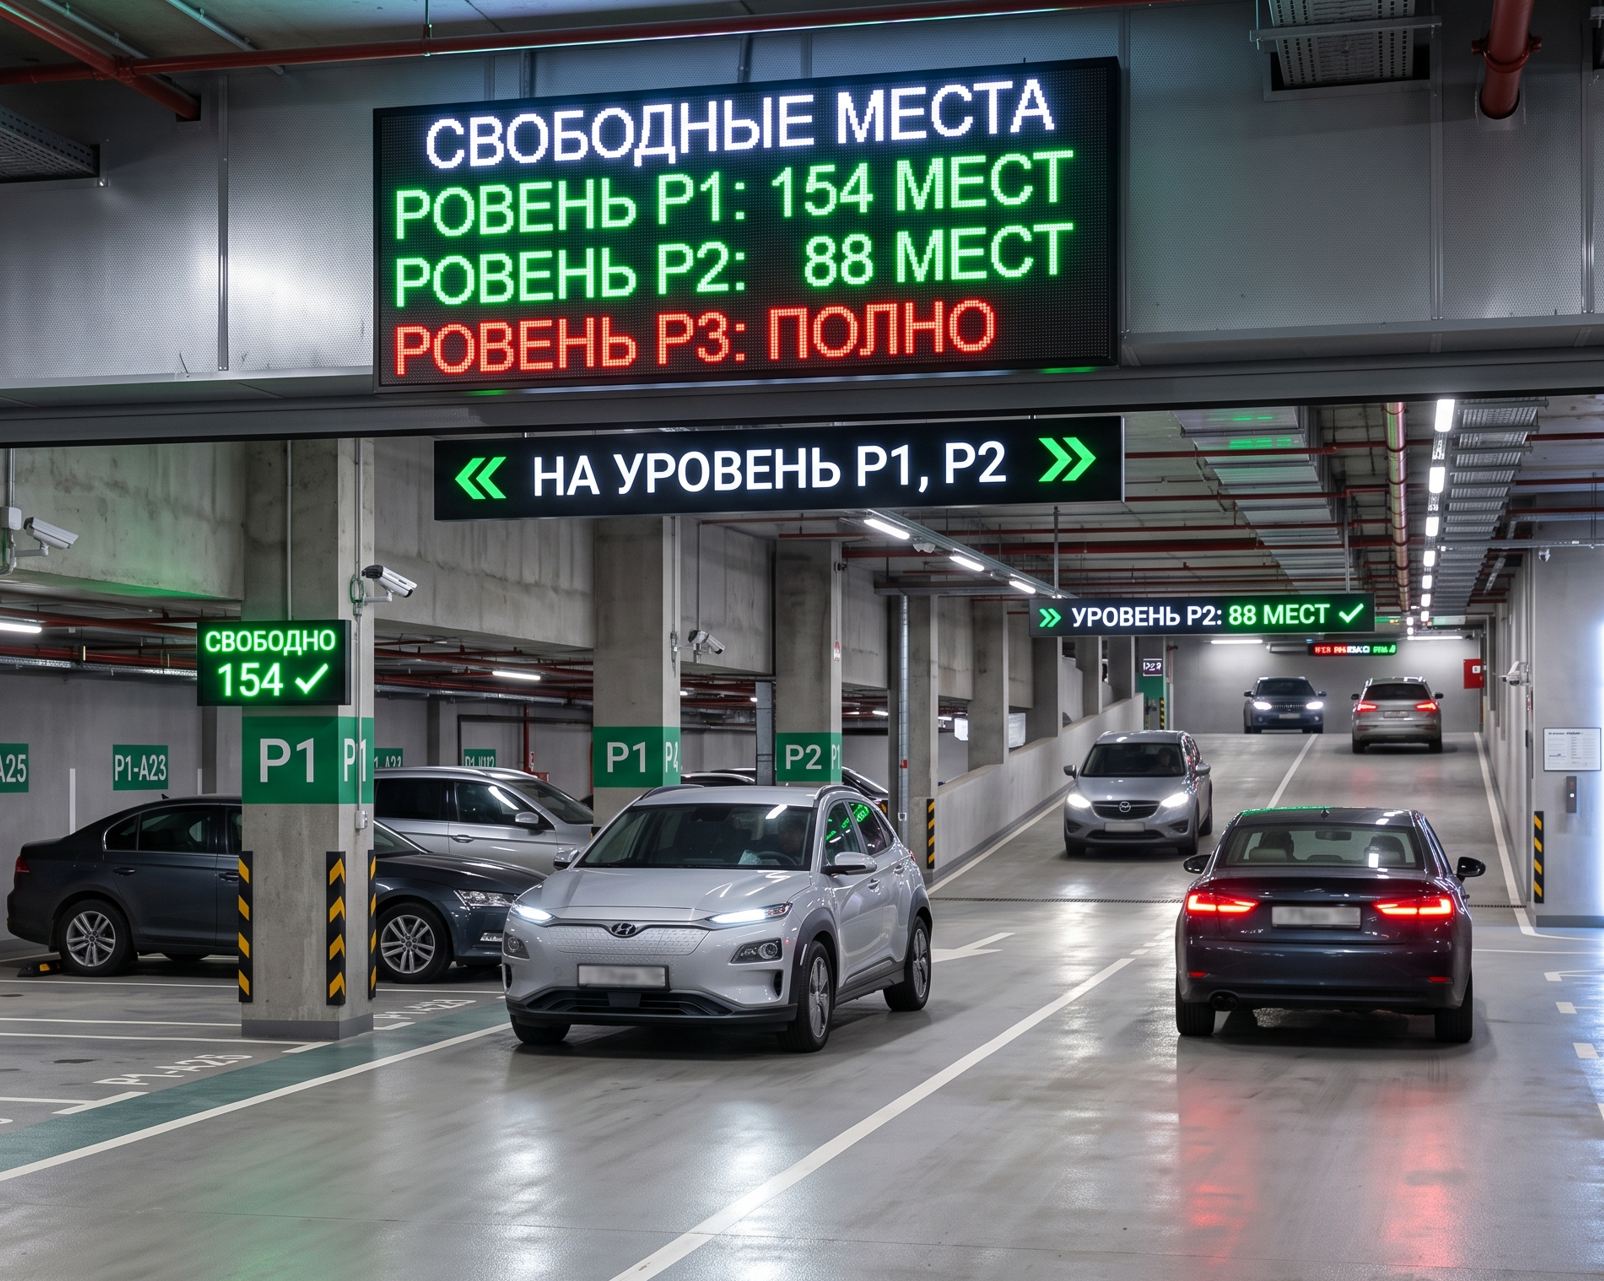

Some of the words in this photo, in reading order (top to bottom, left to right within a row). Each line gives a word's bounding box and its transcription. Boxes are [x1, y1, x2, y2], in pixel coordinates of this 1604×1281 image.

[426, 94, 815, 169] СВОБОДНЫЕ
[836, 78, 1055, 144] МЕСТА
[396, 178, 637, 240] РОВЕНЬ
[657, 171, 745, 225] P1:
[771, 163, 874, 218] 154
[896, 150, 1074, 212] МЕСТ
[396, 247, 637, 308] РОВЕНЬ
[657, 241, 745, 295] P2:
[804, 234, 873, 287] 88
[896, 223, 1074, 283] МЕСТ
[396, 316, 637, 376] РОВЕНЬ
[657, 312, 745, 365] P3:
[769, 299, 995, 361] ПОЛНО
[533, 455, 601, 497] НА
[613, 447, 841, 494] УРОВЕНЬ
[857, 444, 929, 493] P1,
[945, 441, 1007, 484] P2
[1071, 607, 1181, 628] УРОВЕНЬ
[1187, 605, 1222, 626] P2:
[1228, 604, 1257, 626] 88
[1263, 603, 1331, 625] МЕСТ
[204, 629, 336, 656] СВОБОДНО
[217, 663, 284, 697] 154
[114, 754, 168, 782] P1-A23
[260, 737, 314, 783] P1
[343, 738, 367, 782] P1
[606, 741, 646, 773] P1
[785, 744, 822, 770] P2
